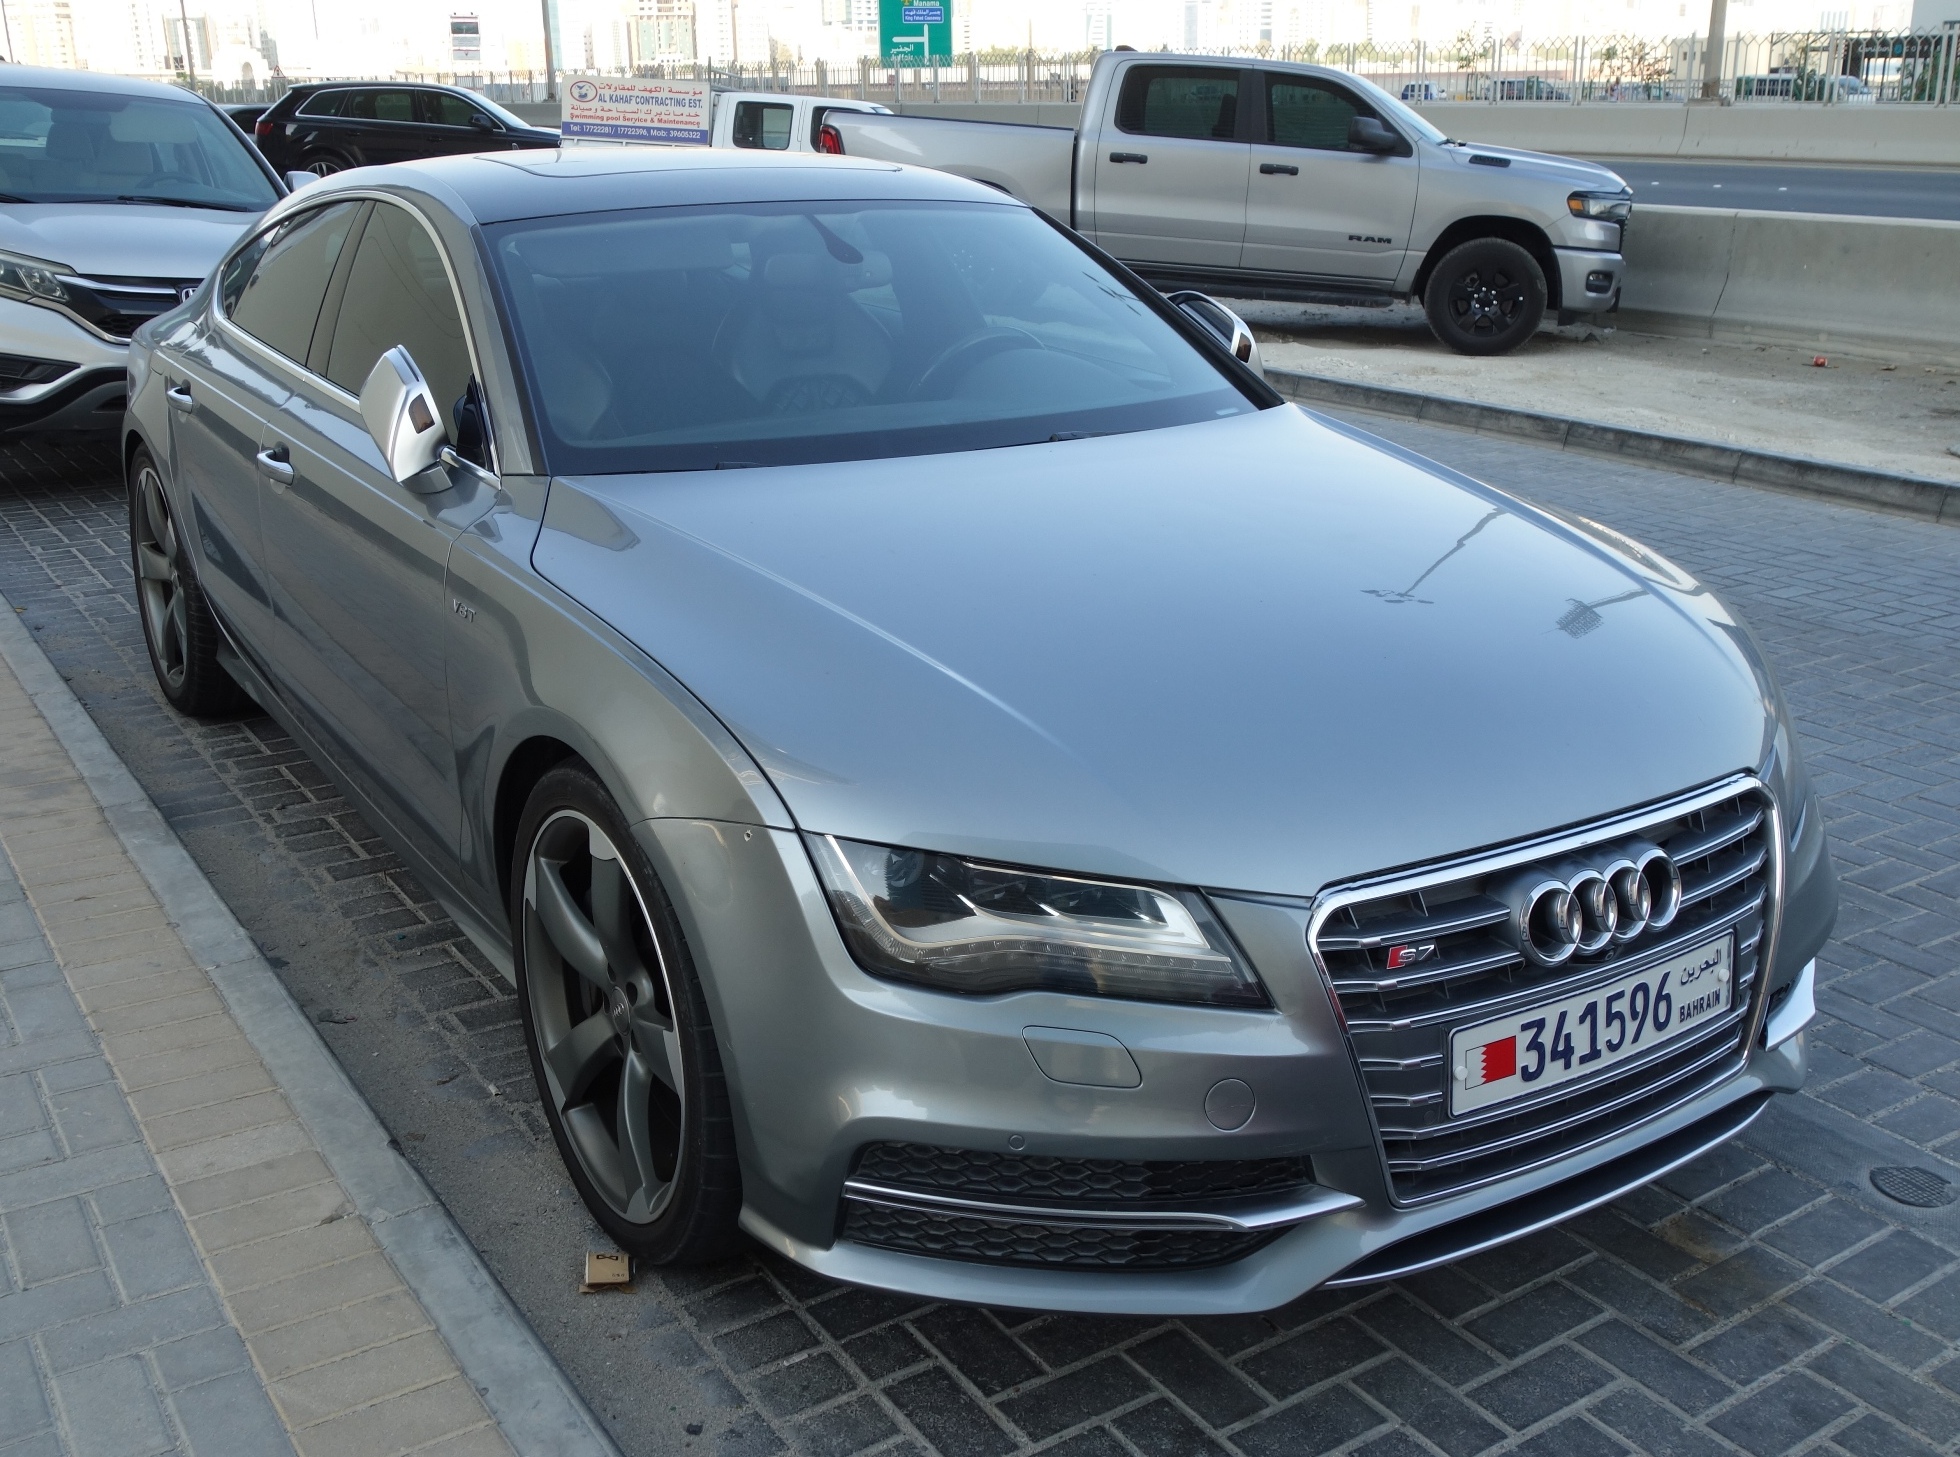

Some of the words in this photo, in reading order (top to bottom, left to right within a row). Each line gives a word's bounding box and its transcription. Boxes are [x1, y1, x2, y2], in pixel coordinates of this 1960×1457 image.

[890, 44, 914, 54] الجفير
[598, 93, 607, 103] AL
[609, 93, 633, 105] KAHAF
[635, 95, 687, 107] CONTRACTING
[688, 98, 703, 109] EST.
[570, 113, 605, 121] Swimming
[657, 118, 701, 126] Maintenance
[569, 124, 581, 132] Tel:
[650, 129, 668, 137] Mob:
[1348, 235, 1392, 244] RAM
[1398, 944, 1436, 964] S7
[1680, 947, 1722, 987] البحرين
[1519, 971, 1673, 1083] 341596
[1679, 987, 1721, 1024] BAHRAIN
